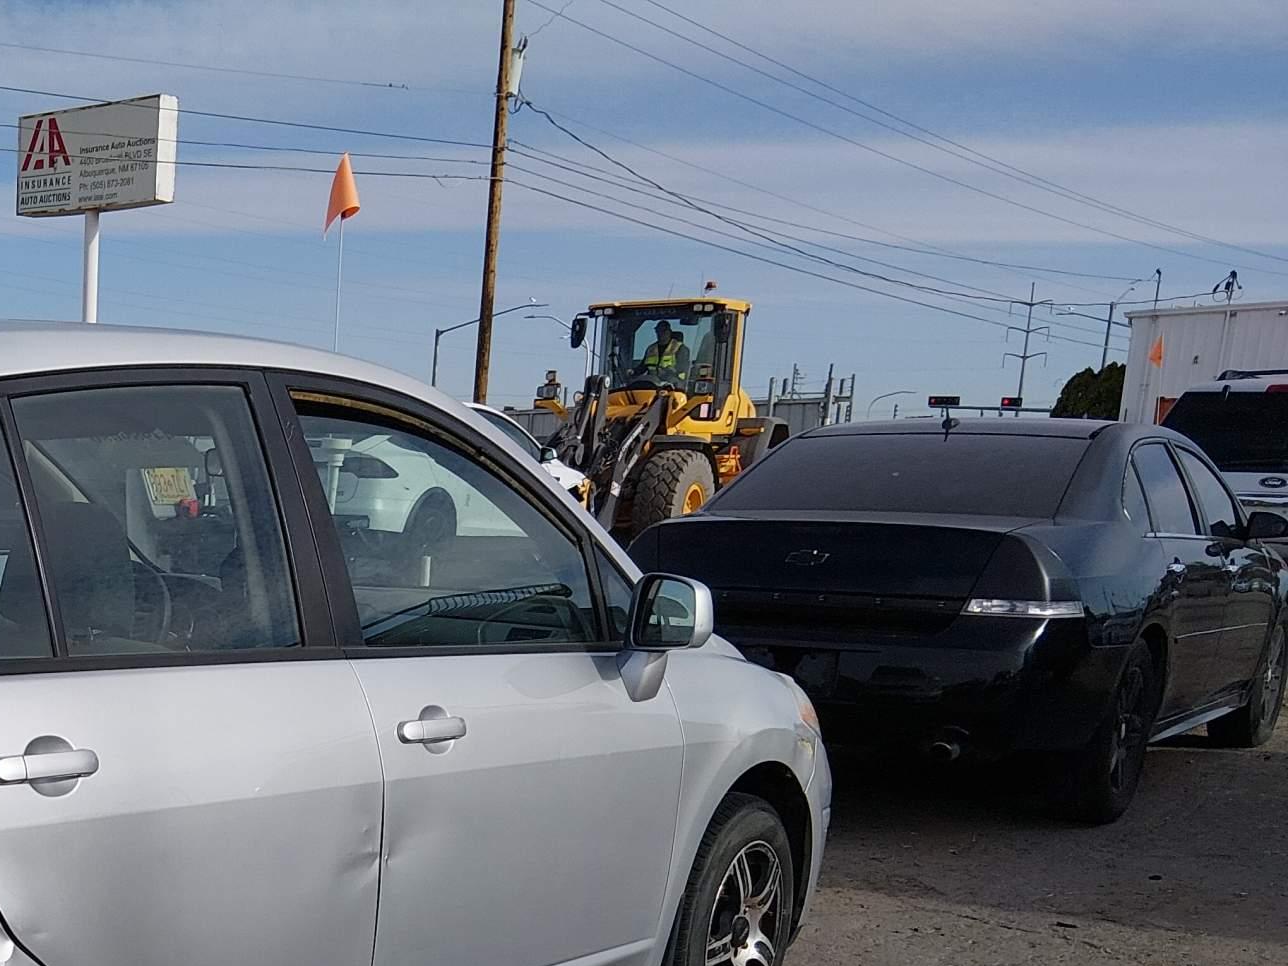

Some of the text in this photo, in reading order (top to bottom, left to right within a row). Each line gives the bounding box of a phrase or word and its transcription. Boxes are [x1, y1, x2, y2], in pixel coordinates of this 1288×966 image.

[79, 138, 156, 154] Insurance Auto Auctions
[21, 176, 72, 190] INSURANCE
[21, 192, 71, 205] AUTO AUCTIONS
